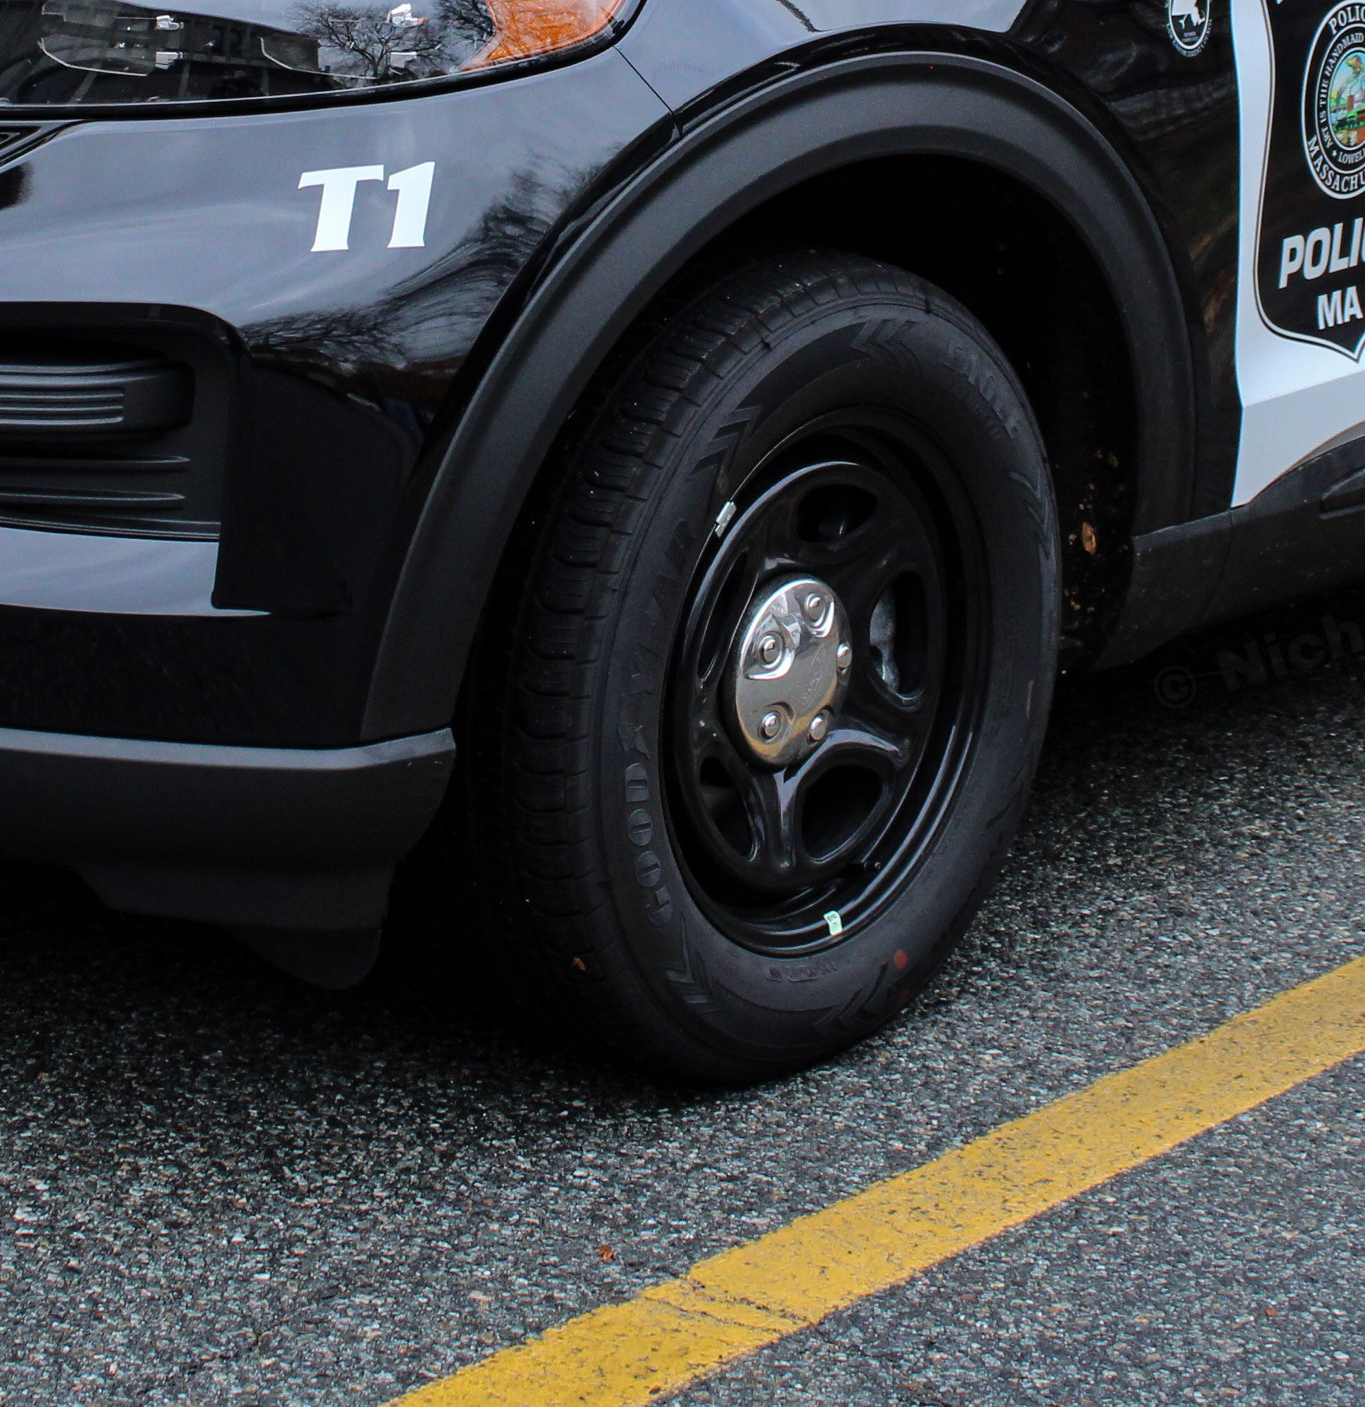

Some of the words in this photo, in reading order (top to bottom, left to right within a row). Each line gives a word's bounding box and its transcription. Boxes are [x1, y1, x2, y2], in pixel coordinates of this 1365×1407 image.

[1319, 76, 1329, 108] THE
[1324, 32, 1364, 75] HANDMAID
[297, 161, 435, 252] T1
[1317, 285, 1364, 331] MA
